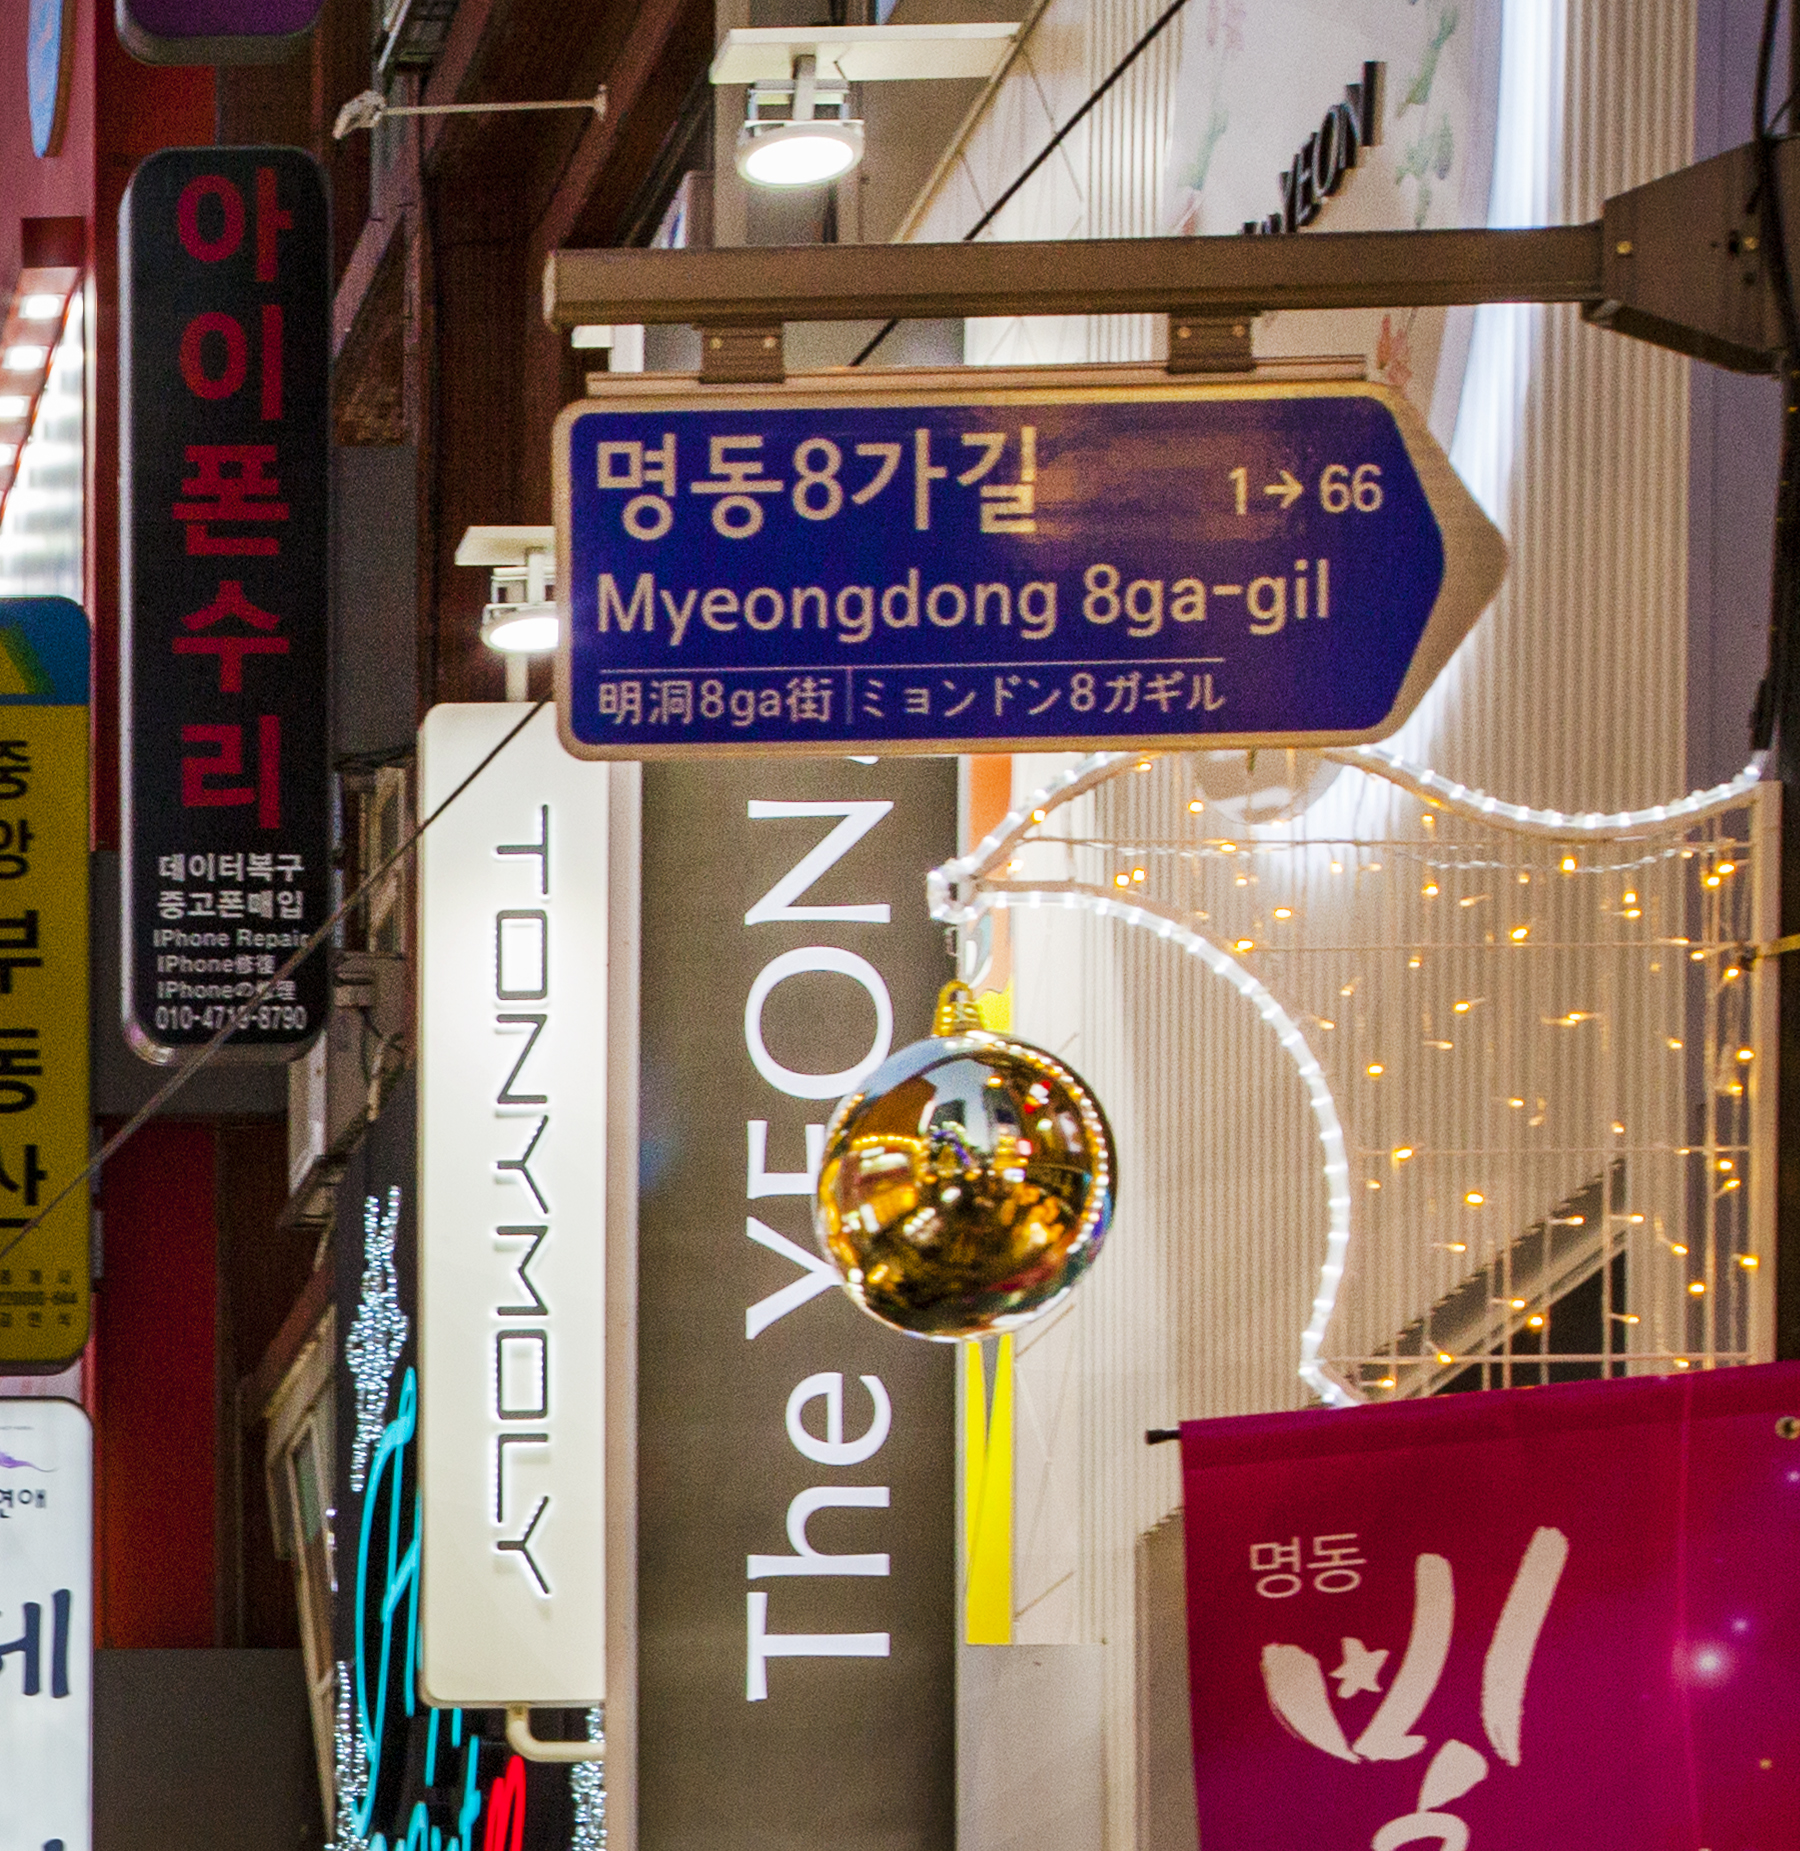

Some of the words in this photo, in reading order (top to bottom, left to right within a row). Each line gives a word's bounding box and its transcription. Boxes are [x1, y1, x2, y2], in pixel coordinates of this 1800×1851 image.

[173, 166, 292, 829] 아이폰수리
[596, 426, 1038, 541] 명동8가길
[1227, 465, 1248, 516] 1
[1320, 464, 1382, 514] 66
[598, 568, 1058, 646] Myeongdong
[1082, 558, 1331, 640] 8ga-gil
[599, 672, 833, 728] 明洞8ga街
[861, 670, 1226, 716] ミョンドン8ガギル
[157, 889, 304, 920] 중고폰매입
[158, 852, 305, 882] 데이터복구
[743, 799, 895, 1341] YEON
[495, 804, 550, 1596] TONYMOLY
[746, 1371, 893, 1702] The
[1250, 1532, 1367, 1599] 명동
